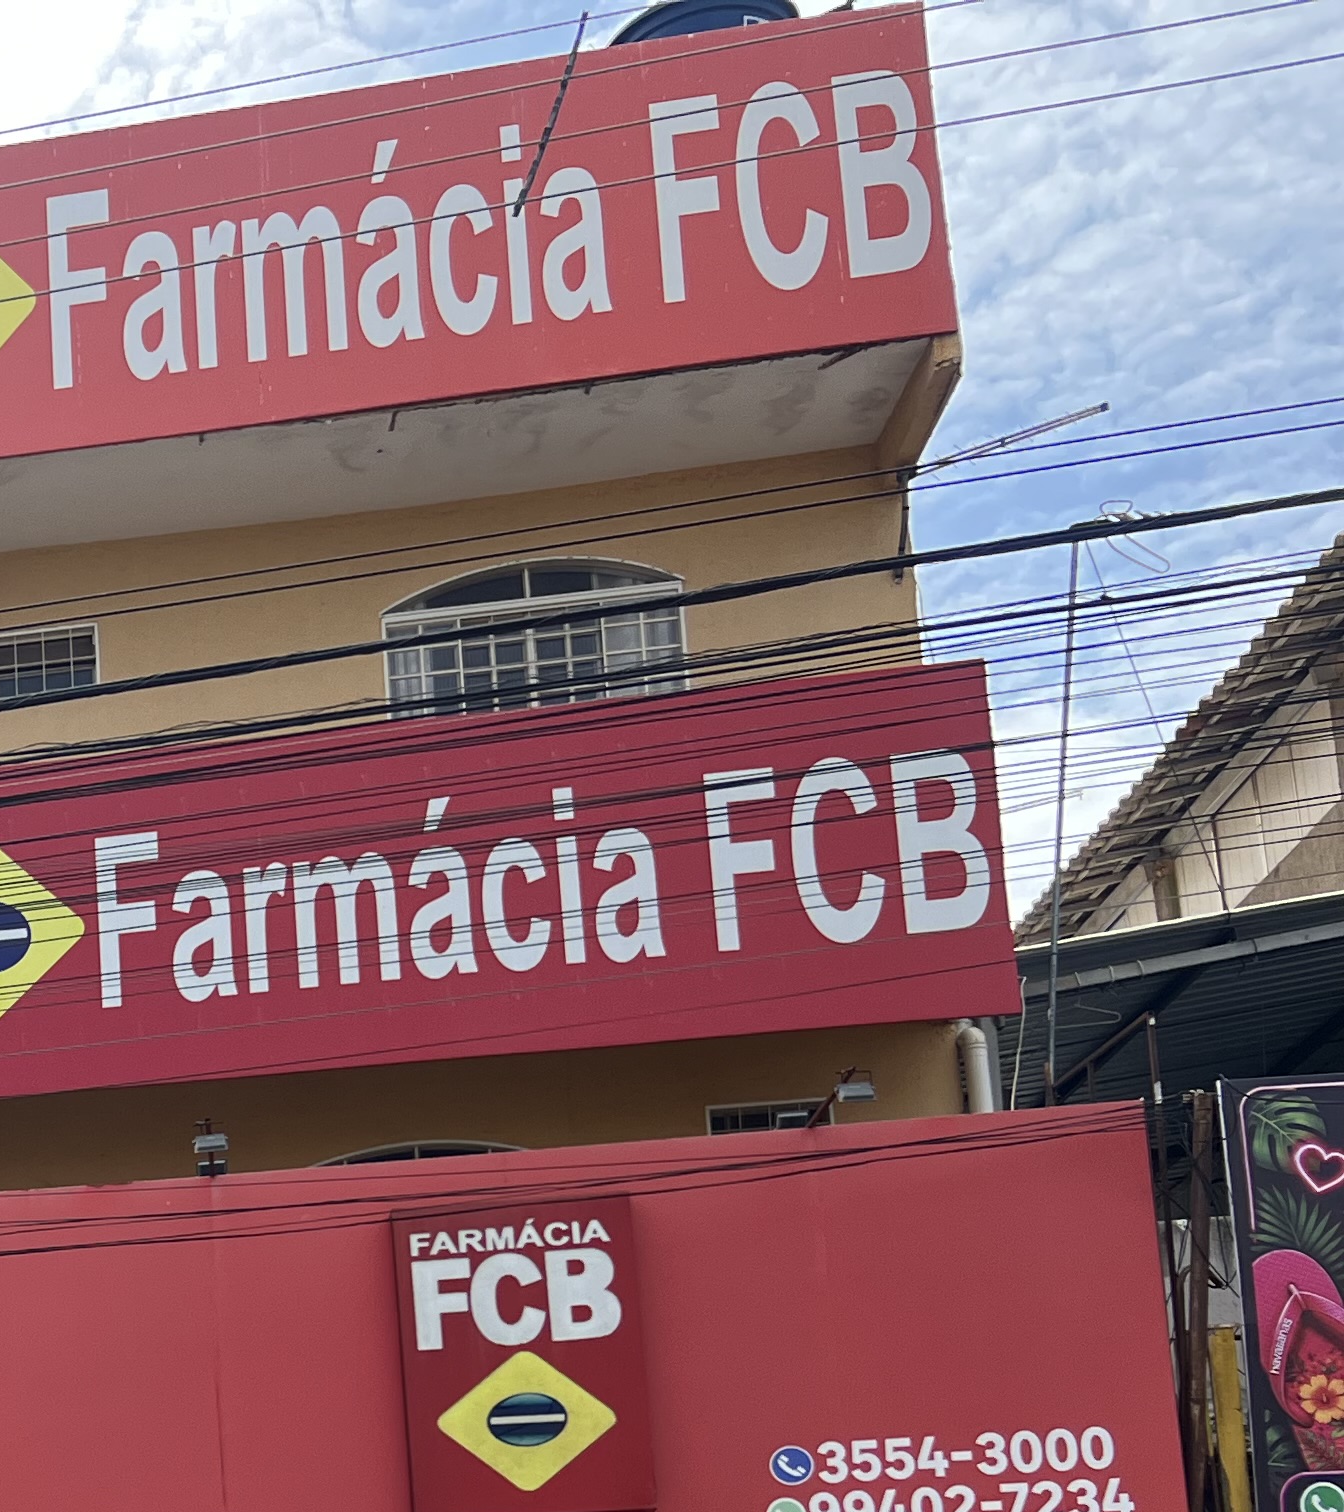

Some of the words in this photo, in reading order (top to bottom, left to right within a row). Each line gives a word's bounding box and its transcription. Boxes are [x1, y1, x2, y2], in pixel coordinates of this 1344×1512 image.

[43, 124, 613, 390] Farmácia
[648, 68, 933, 305] FCB
[93, 786, 667, 1010] Farmácia
[703, 748, 992, 954] FCB
[408, 1217, 611, 1258] FARMÁCIA
[410, 1246, 622, 1352] FCB
[817, 1426, 1116, 1484] 3554-3000
